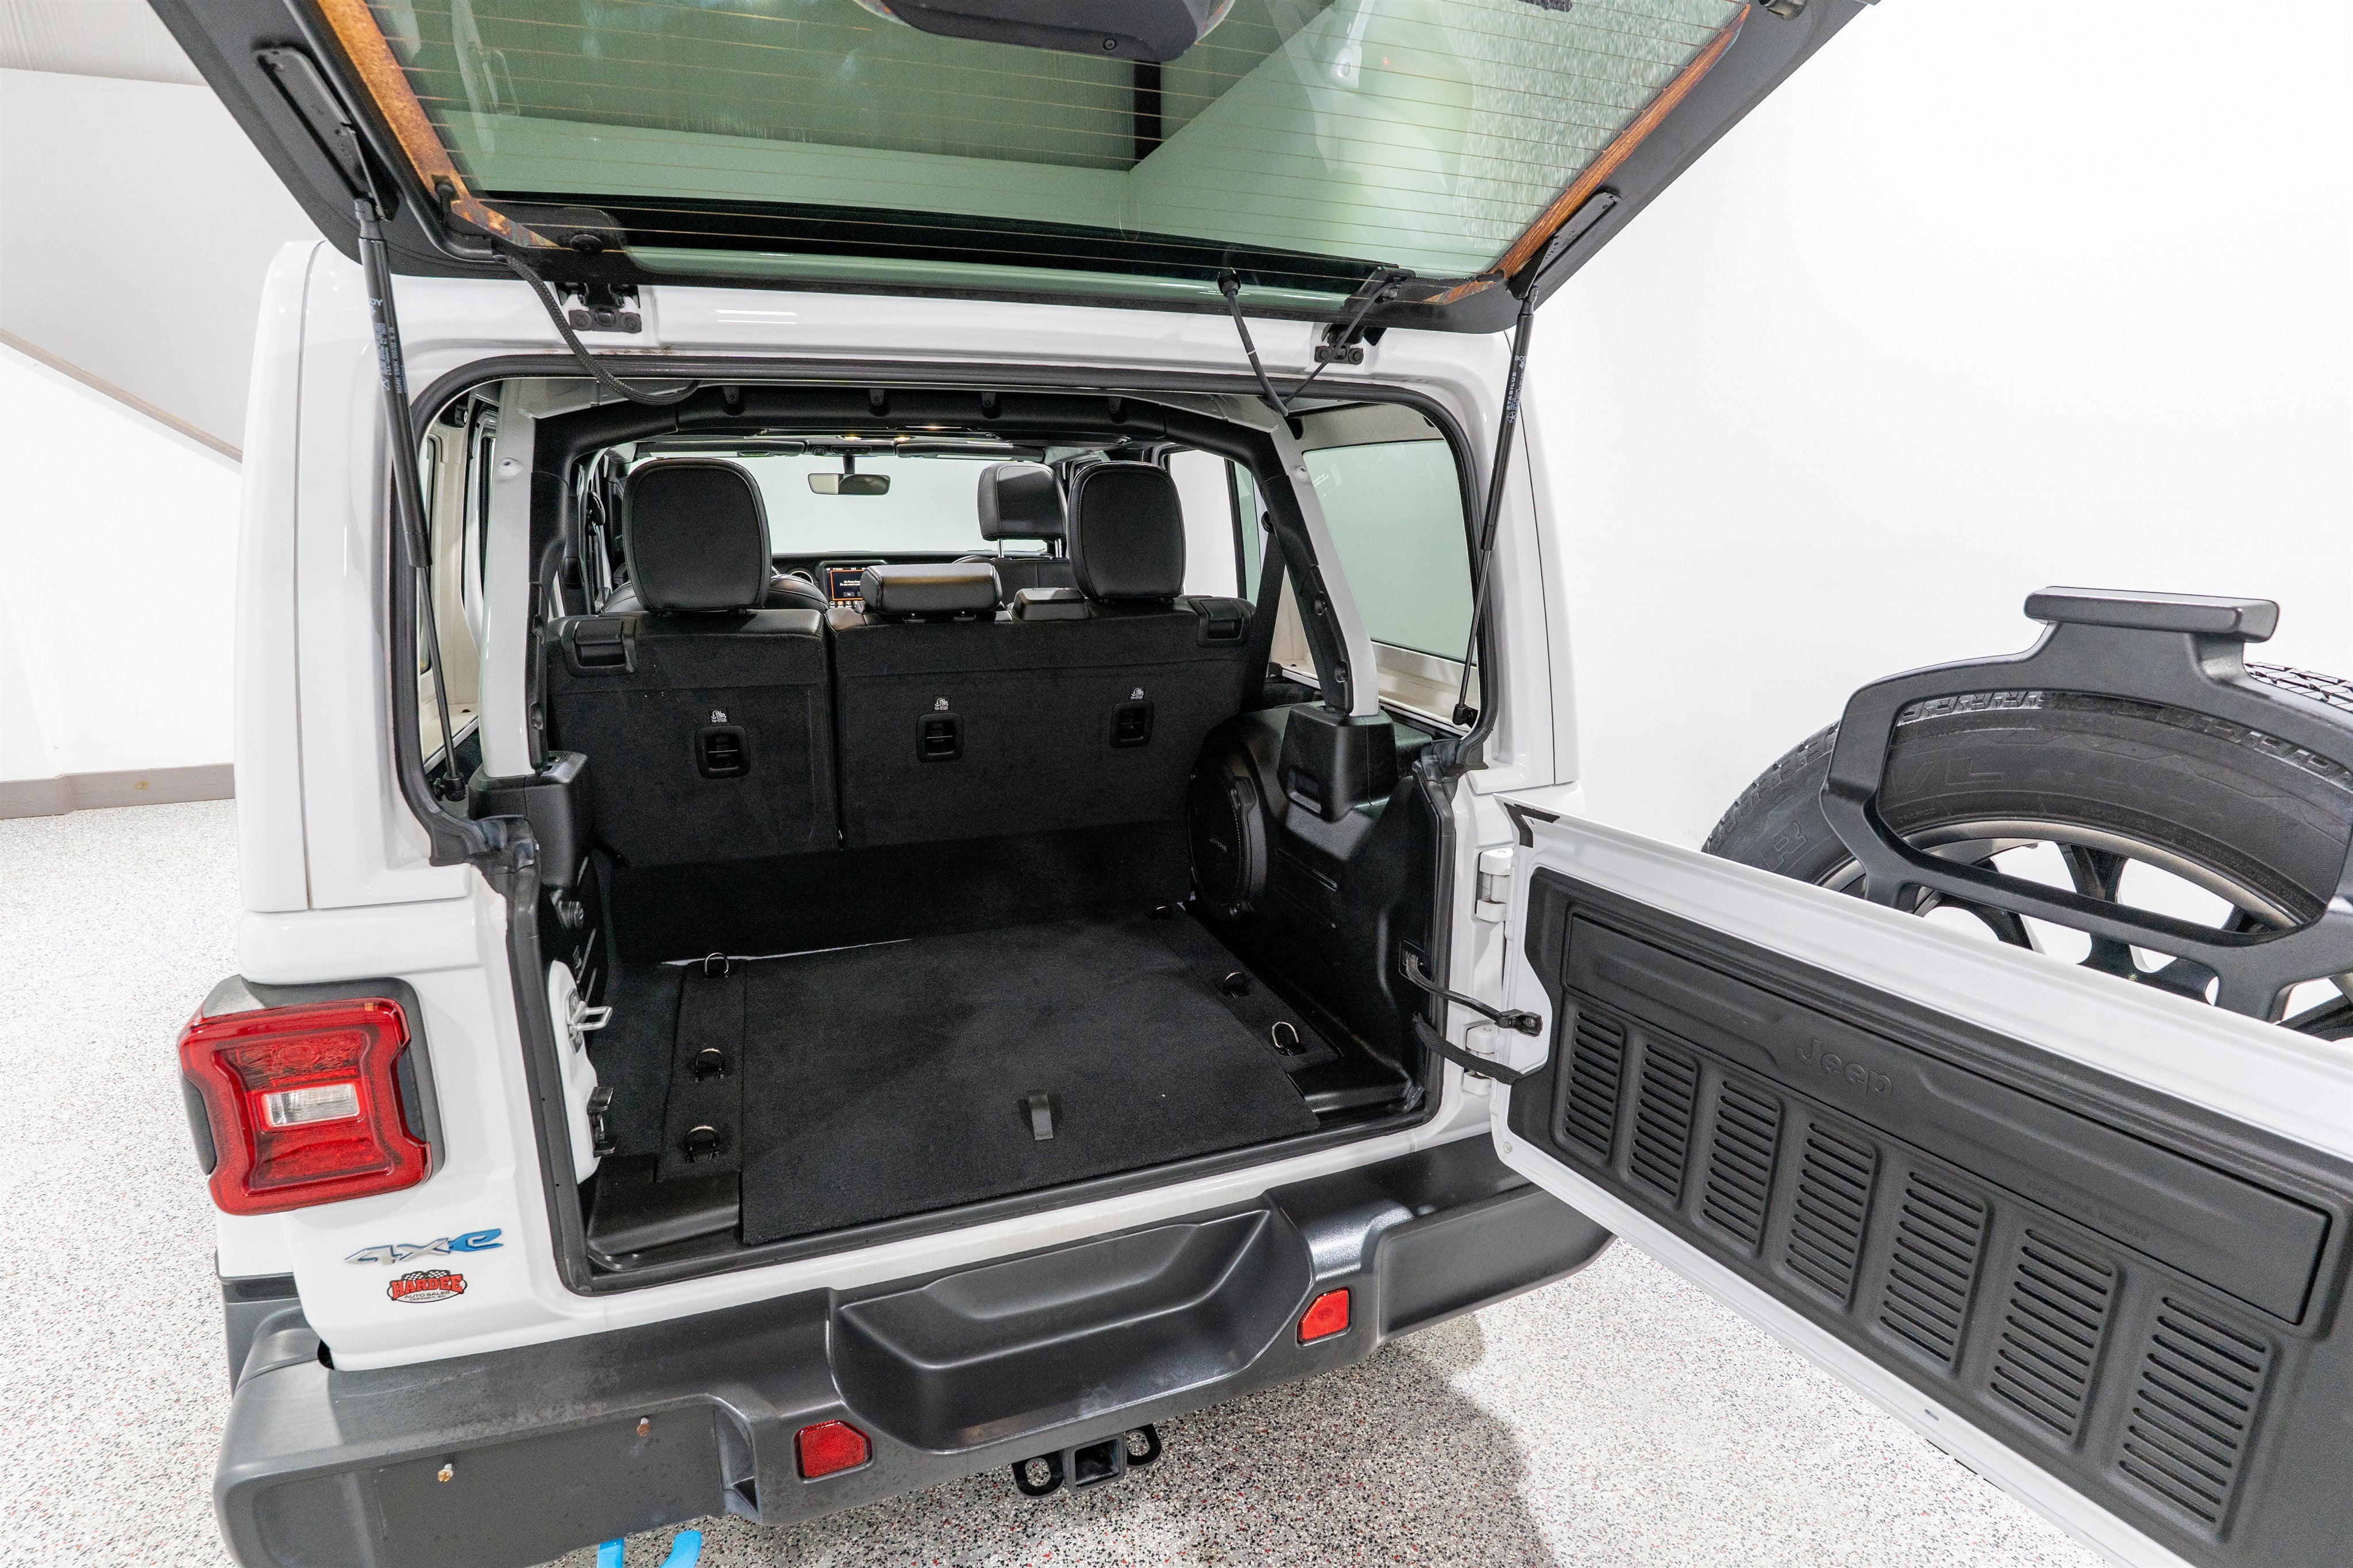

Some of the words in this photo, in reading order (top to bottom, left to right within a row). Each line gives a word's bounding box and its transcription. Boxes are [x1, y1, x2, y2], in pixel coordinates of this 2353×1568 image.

[1506, 372, 1517, 410] STABILUS
[1795, 1038, 1893, 1097] Jeep
[391, 1274, 464, 1300] HARDEE
